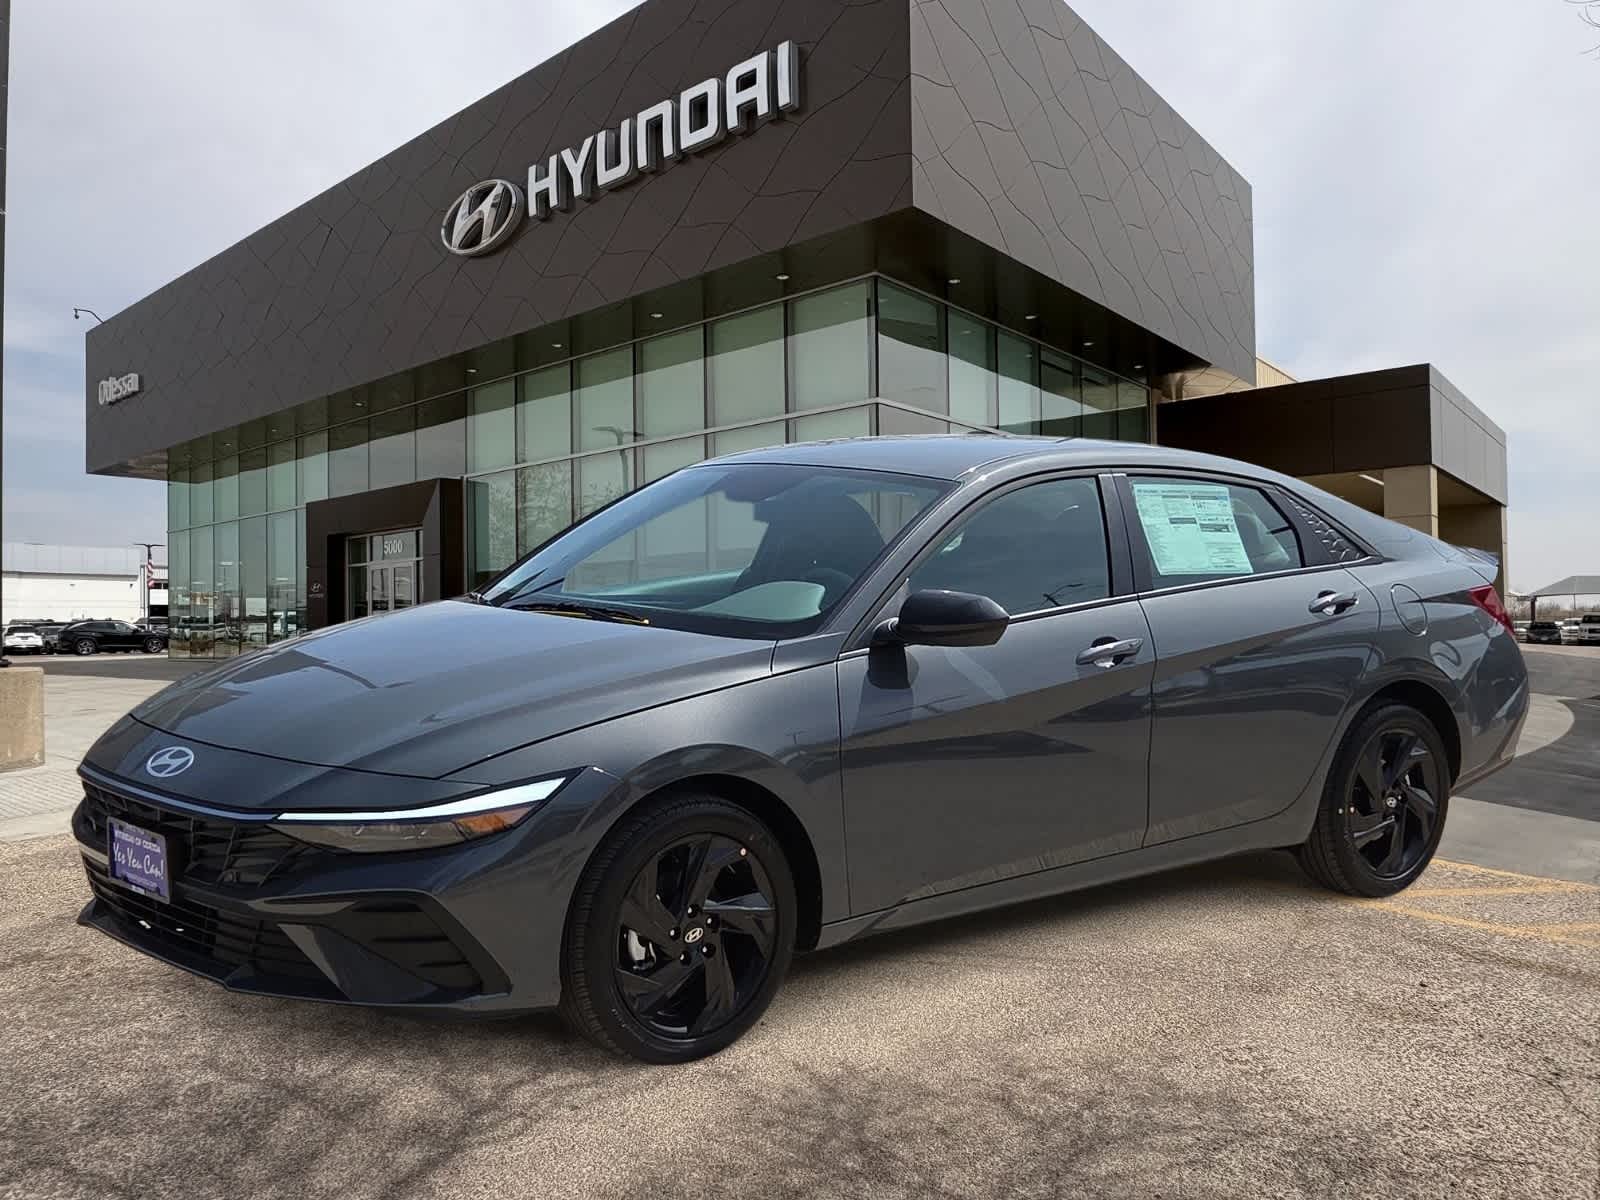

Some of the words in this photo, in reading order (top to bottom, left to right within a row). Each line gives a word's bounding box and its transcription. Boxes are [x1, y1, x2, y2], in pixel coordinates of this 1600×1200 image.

[527, 39, 799, 217] HYUNDAI
[98, 373, 139, 405] Odessa
[383, 539, 403, 555] 5000
[113, 841, 126, 865] Yes
[127, 847, 143, 869] You
[143, 854, 165, 880] Can!
